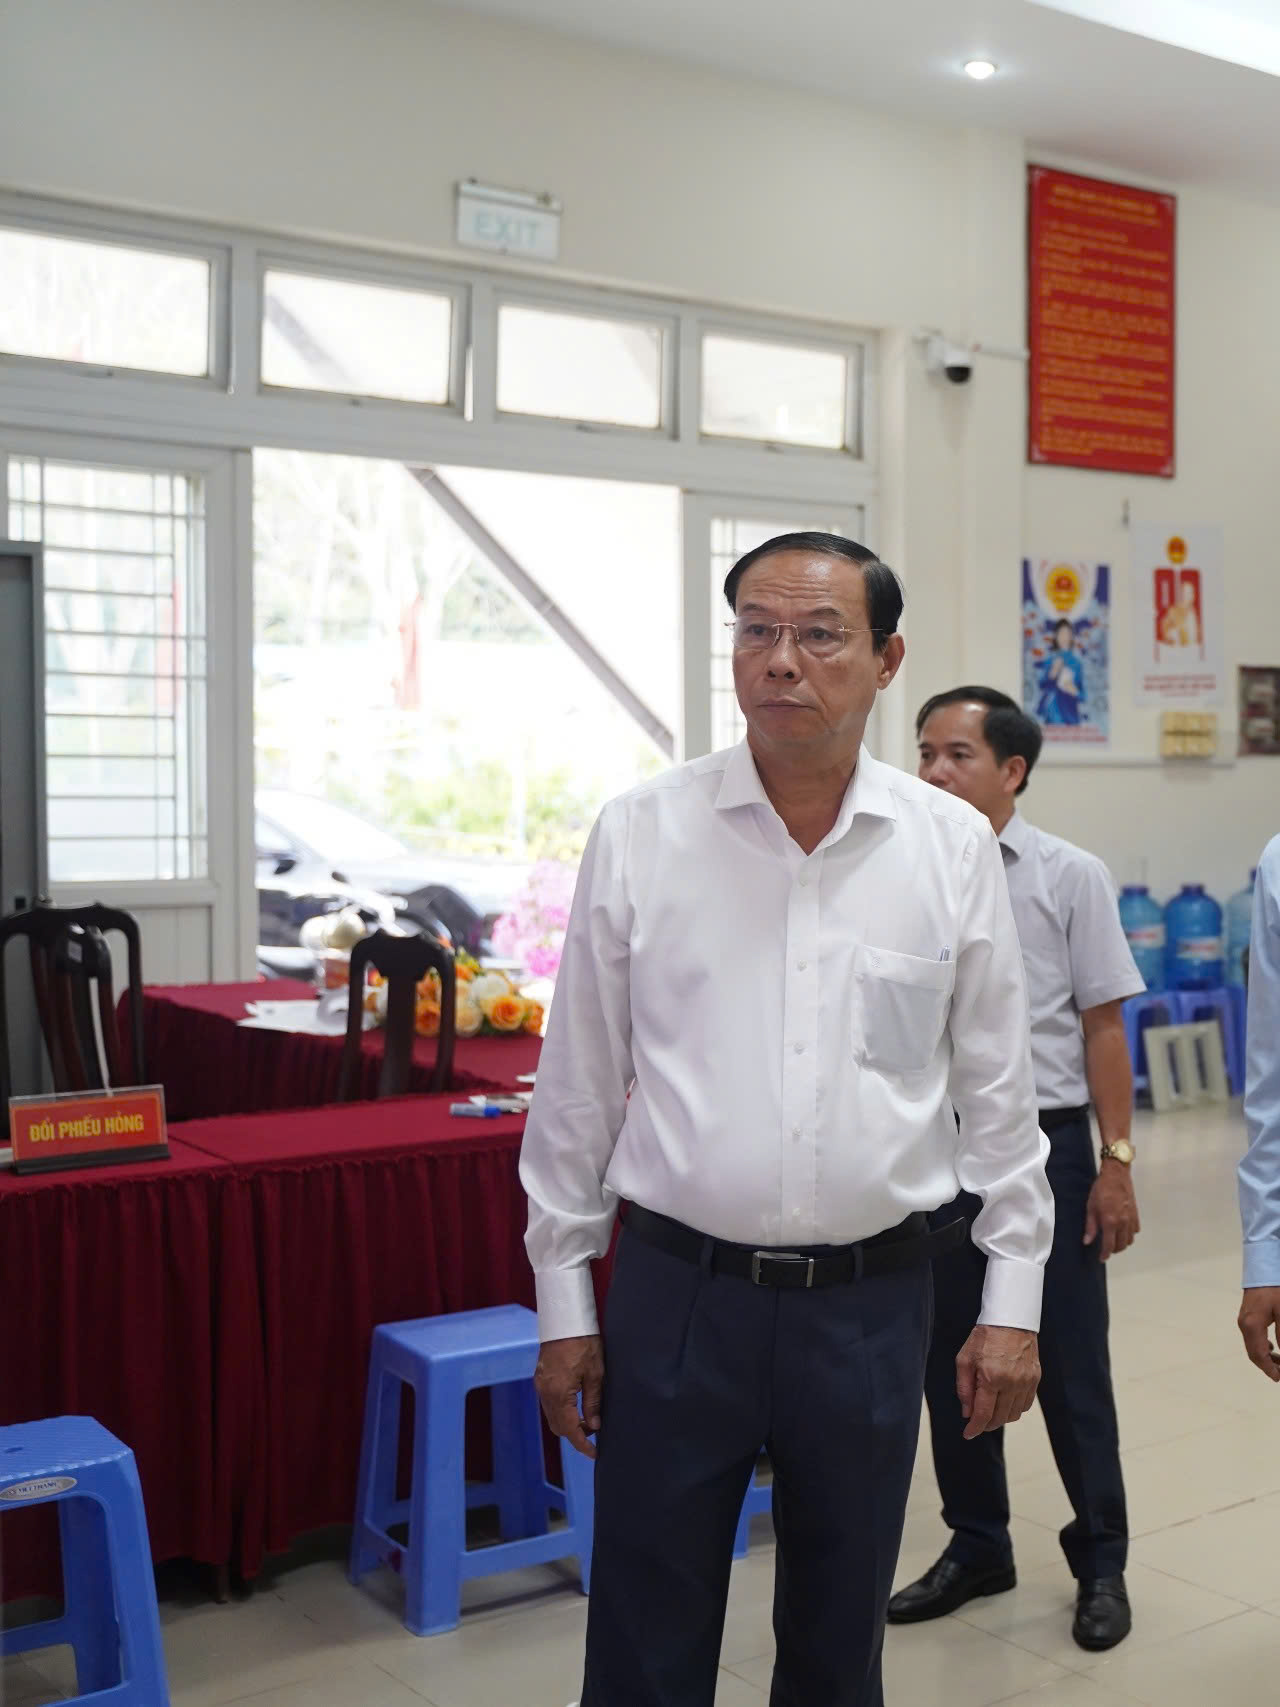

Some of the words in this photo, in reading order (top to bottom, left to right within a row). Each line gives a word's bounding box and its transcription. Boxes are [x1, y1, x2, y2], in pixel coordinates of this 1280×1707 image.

[474, 211, 541, 248] EXIT
[30, 1116, 55, 1142] ĐỔI
[58, 1113, 101, 1139] PHIẾU
[104, 1110, 144, 1135] HỎNG
